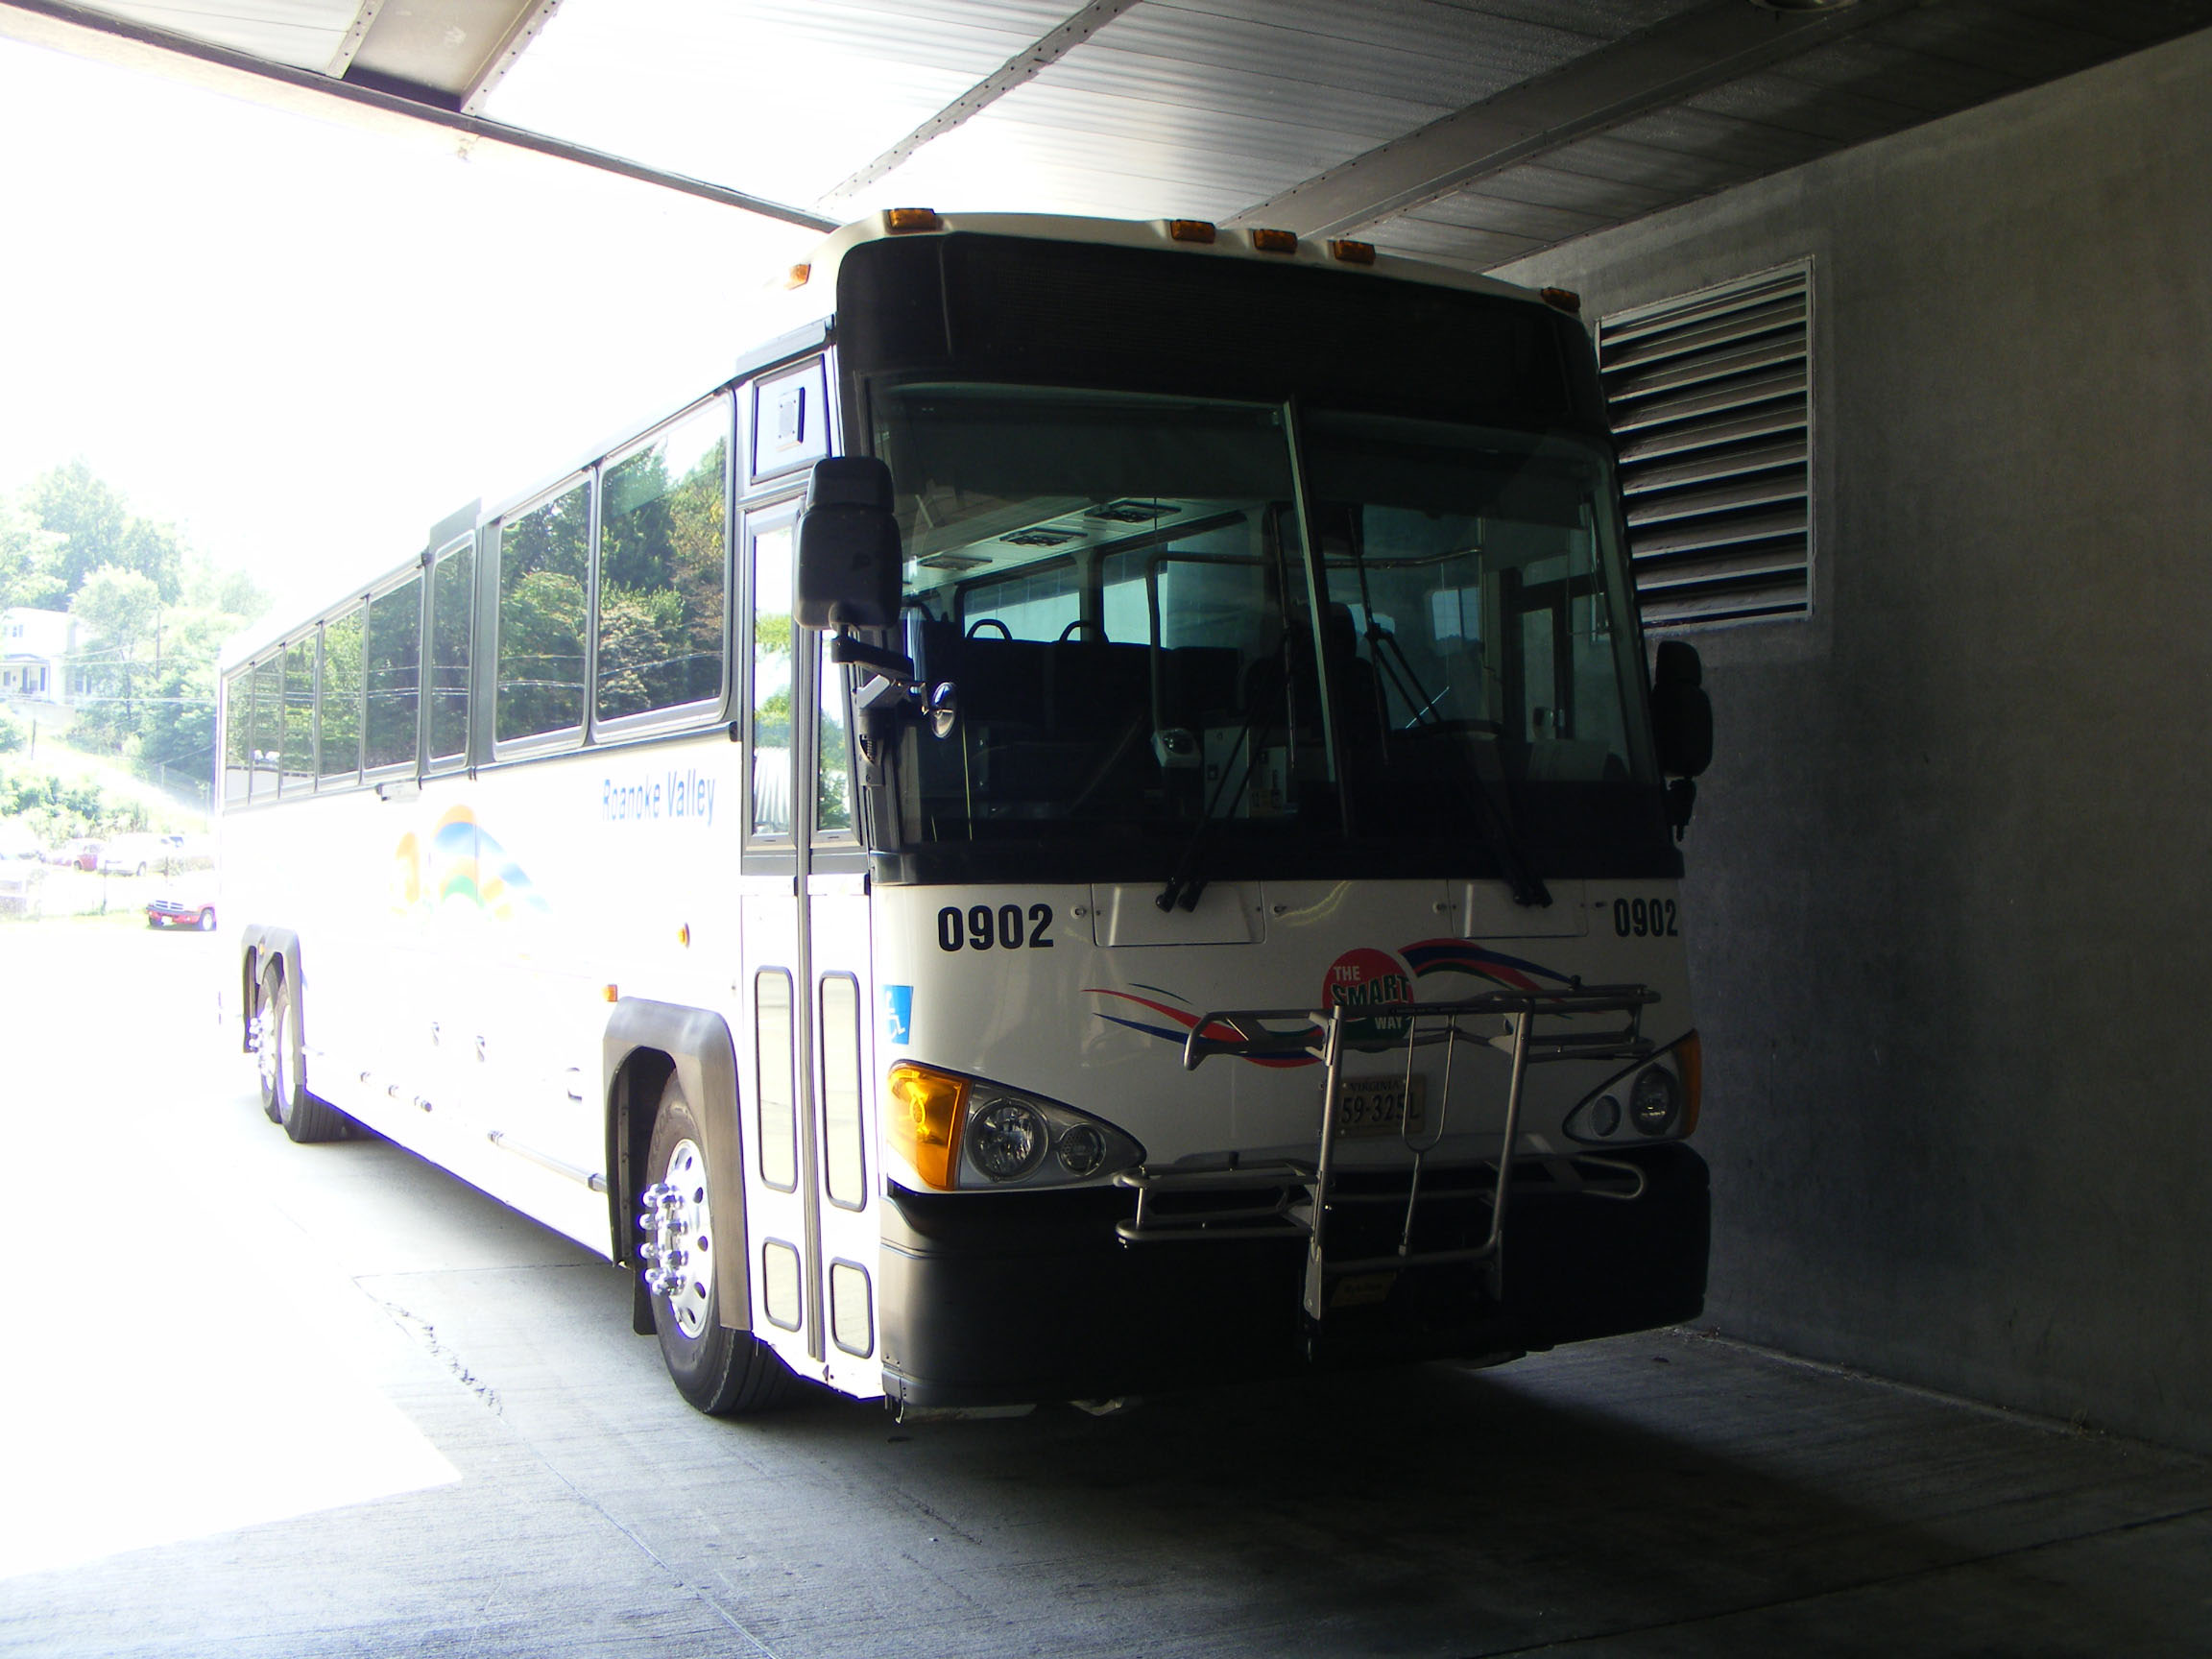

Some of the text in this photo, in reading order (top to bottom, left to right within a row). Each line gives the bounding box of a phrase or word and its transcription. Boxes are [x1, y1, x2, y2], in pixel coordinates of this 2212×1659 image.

[602, 767, 716, 828] Roanoke Valley
[938, 903, 1053, 951] 0902
[1614, 899, 1678, 938] 0902
[1331, 974, 1409, 1006] SMART
[1333, 966, 1361, 982] THE
[1375, 1015, 1402, 1030] WAY
